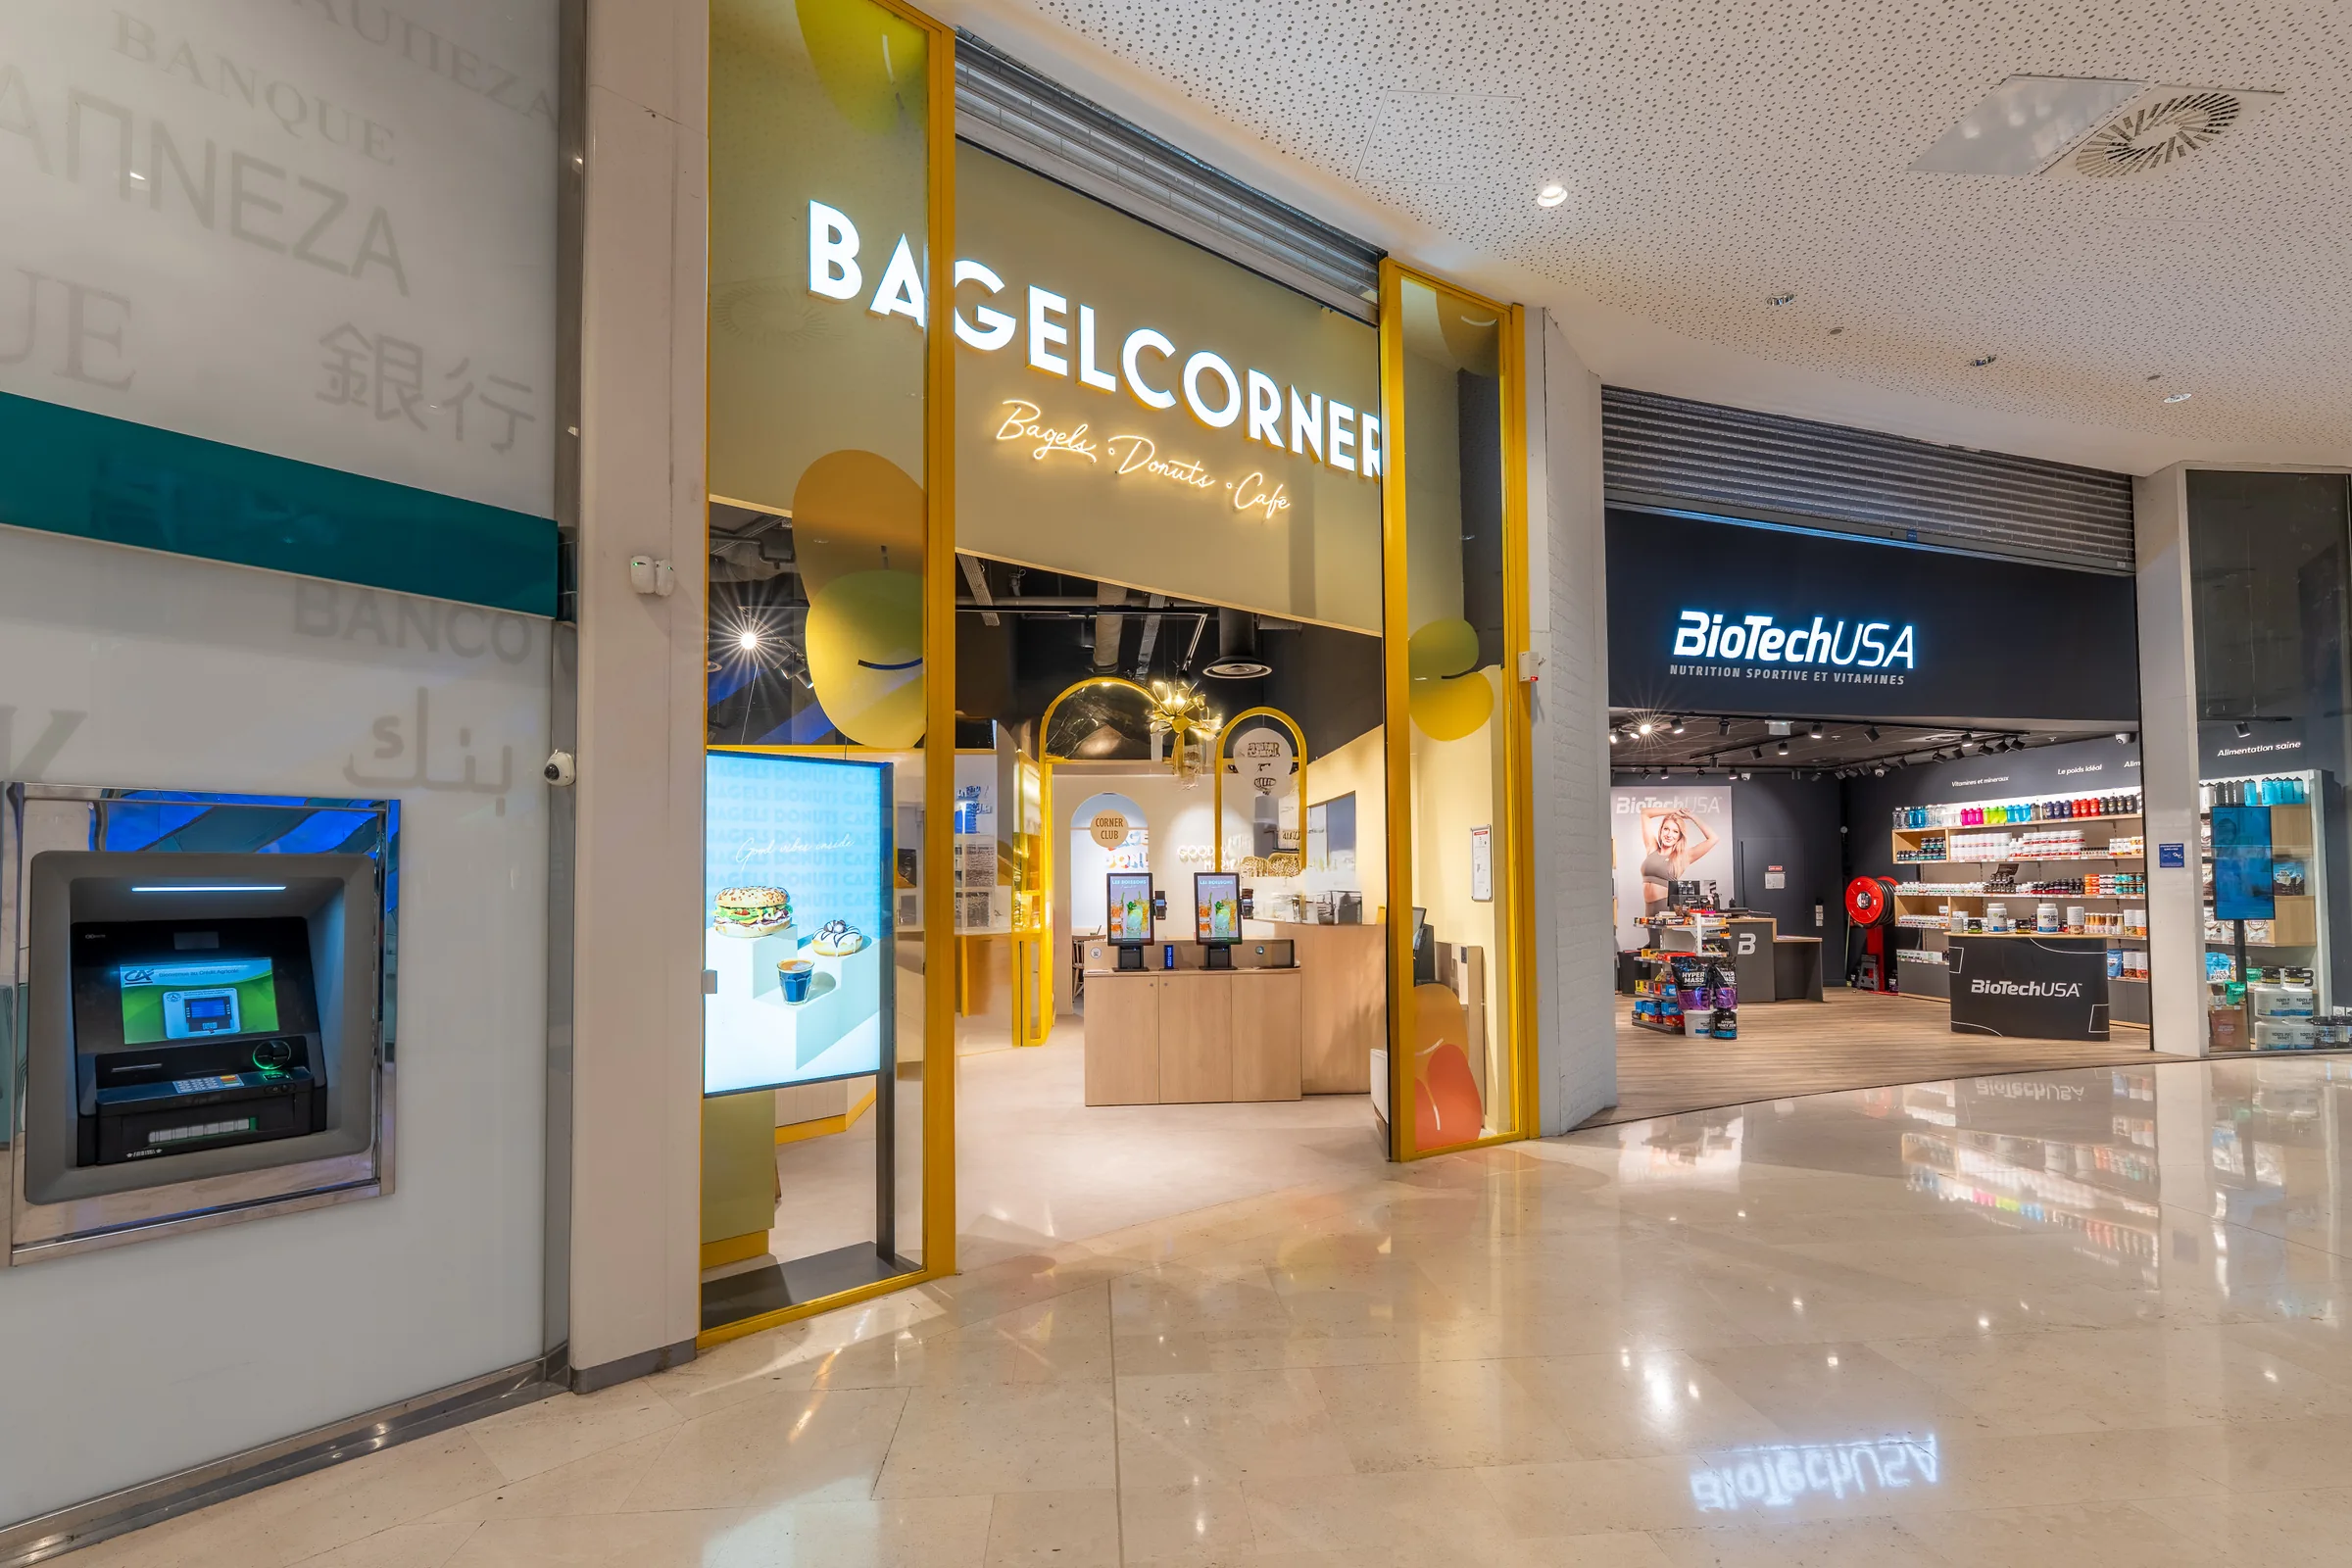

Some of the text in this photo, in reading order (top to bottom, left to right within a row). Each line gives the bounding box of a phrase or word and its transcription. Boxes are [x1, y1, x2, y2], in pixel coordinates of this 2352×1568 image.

[110, 9, 396, 166] BANQUE
[808, 199, 1381, 480] BAGELCORNER
[314, 320, 536, 455] 銀行
[996, 400, 1097, 463] Bagels
[1107, 434, 1216, 488] Donuts
[292, 582, 532, 664] BANCO
[1673, 611, 1914, 669] BioTechUSA
[1669, 663, 1905, 685] NUTRITION SPORTIVE ET VITAMINES
[2217, 741, 2301, 757] Alimentation saine
[1095, 817, 1124, 828] CORNER
[1100, 830, 1119, 840] CLUB
[1738, 933, 1756, 956] B
